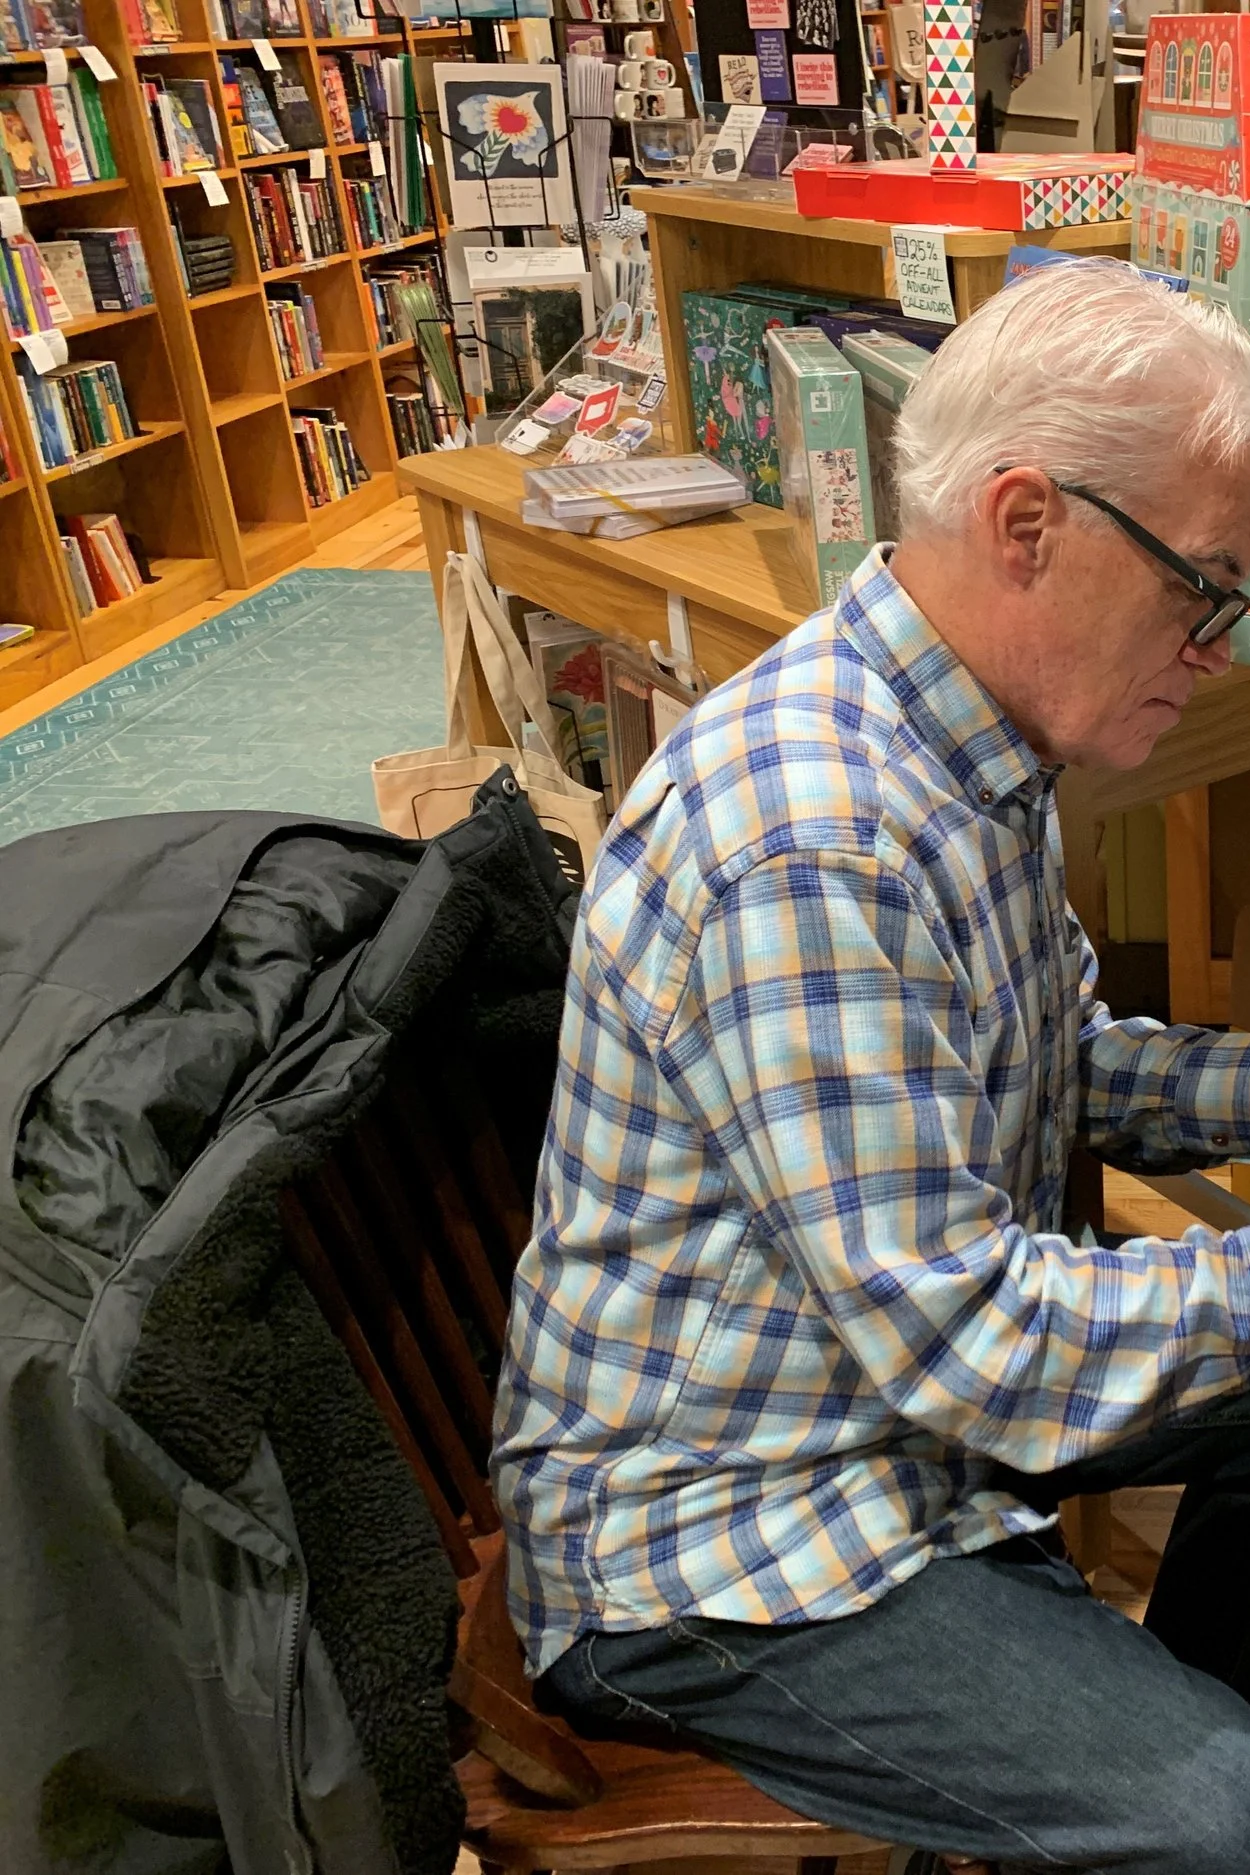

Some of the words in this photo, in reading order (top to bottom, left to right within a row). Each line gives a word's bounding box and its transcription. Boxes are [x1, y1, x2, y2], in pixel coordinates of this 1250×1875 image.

[1224, 224, 1235, 248] 24
[909, 239, 937, 261] 25%
[906, 280, 940, 295] ADVENT
[902, 296, 953, 316] CALENDARS
[824, 569, 836, 606] IGSAW
